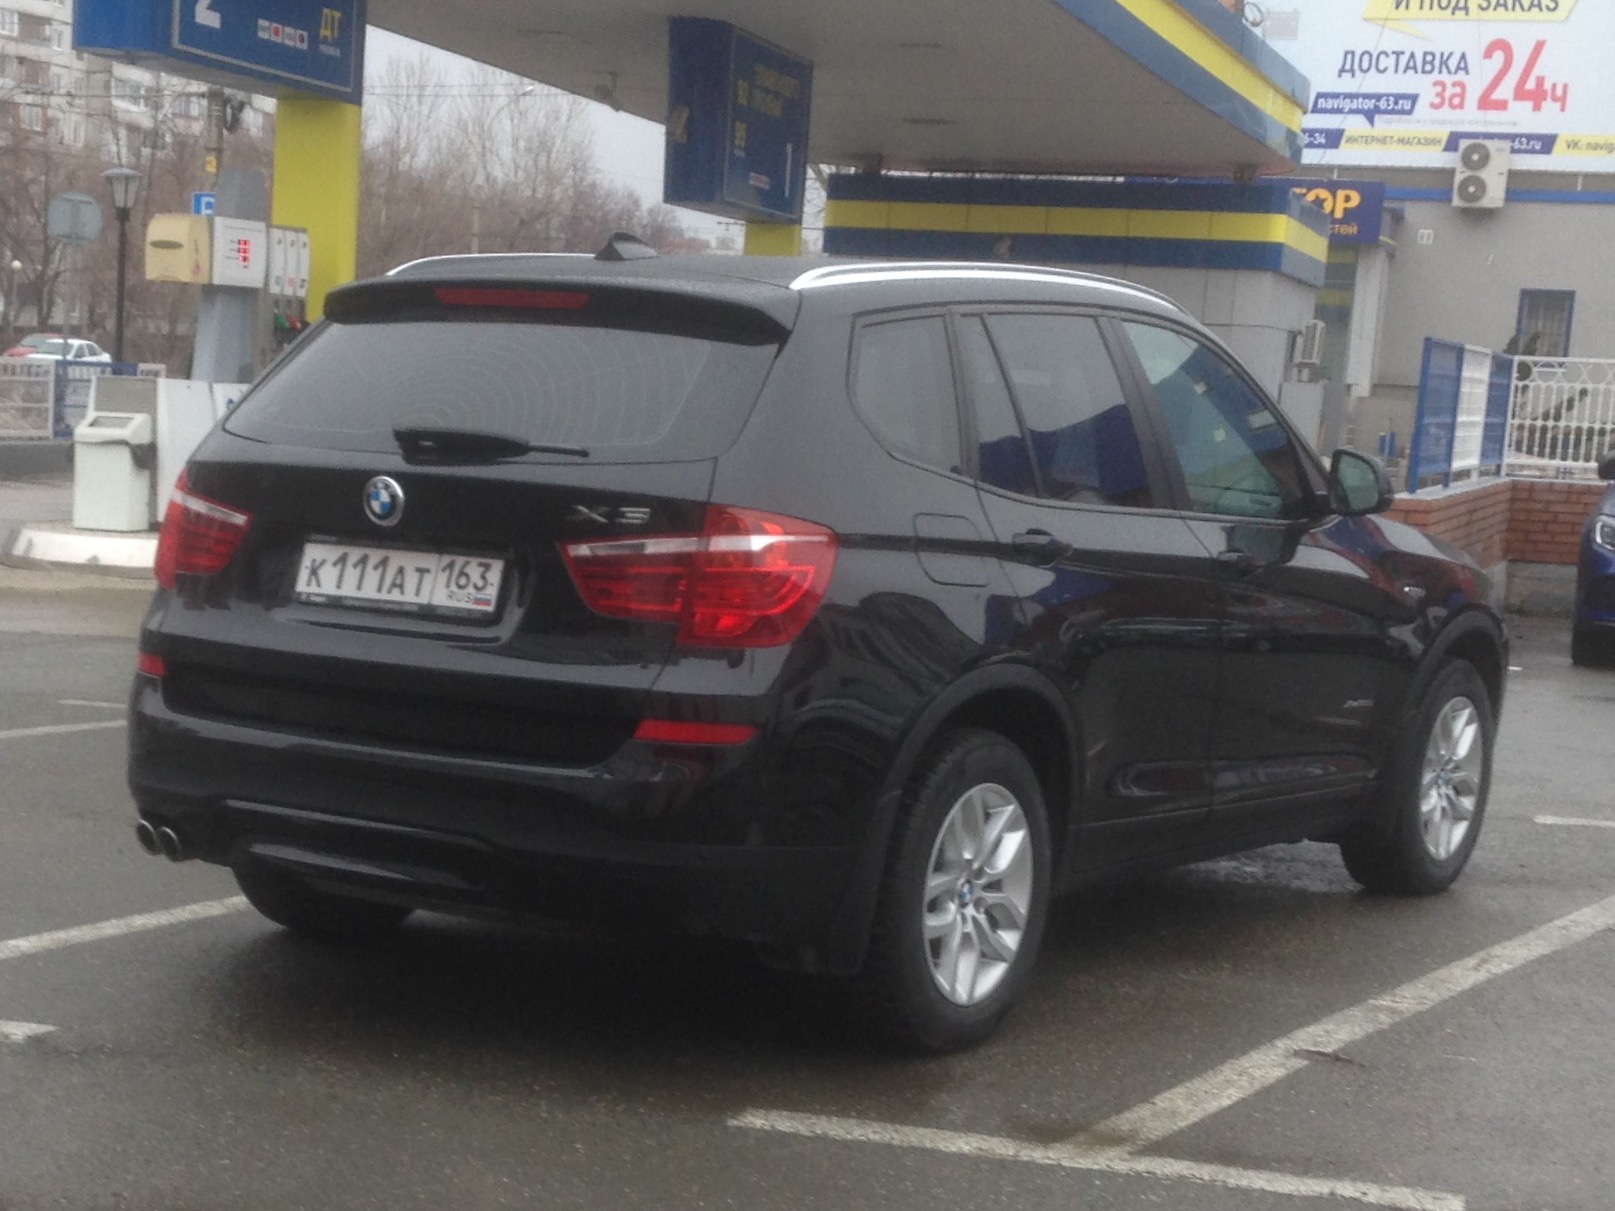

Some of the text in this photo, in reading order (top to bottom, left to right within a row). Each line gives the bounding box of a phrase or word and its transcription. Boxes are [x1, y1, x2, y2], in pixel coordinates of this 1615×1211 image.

[319, 7, 342, 42] ДТ
[1337, 50, 1470, 78] ДОСТАВКА
[1317, 95, 1412, 112] navigator-63.ru
[1429, 80, 1467, 110] за
[1345, 134, 1442, 147] ИНТЕРНЕТ-МАГАЗИН
[565, 504, 650, 524] X3
[441, 558, 493, 592] 163
